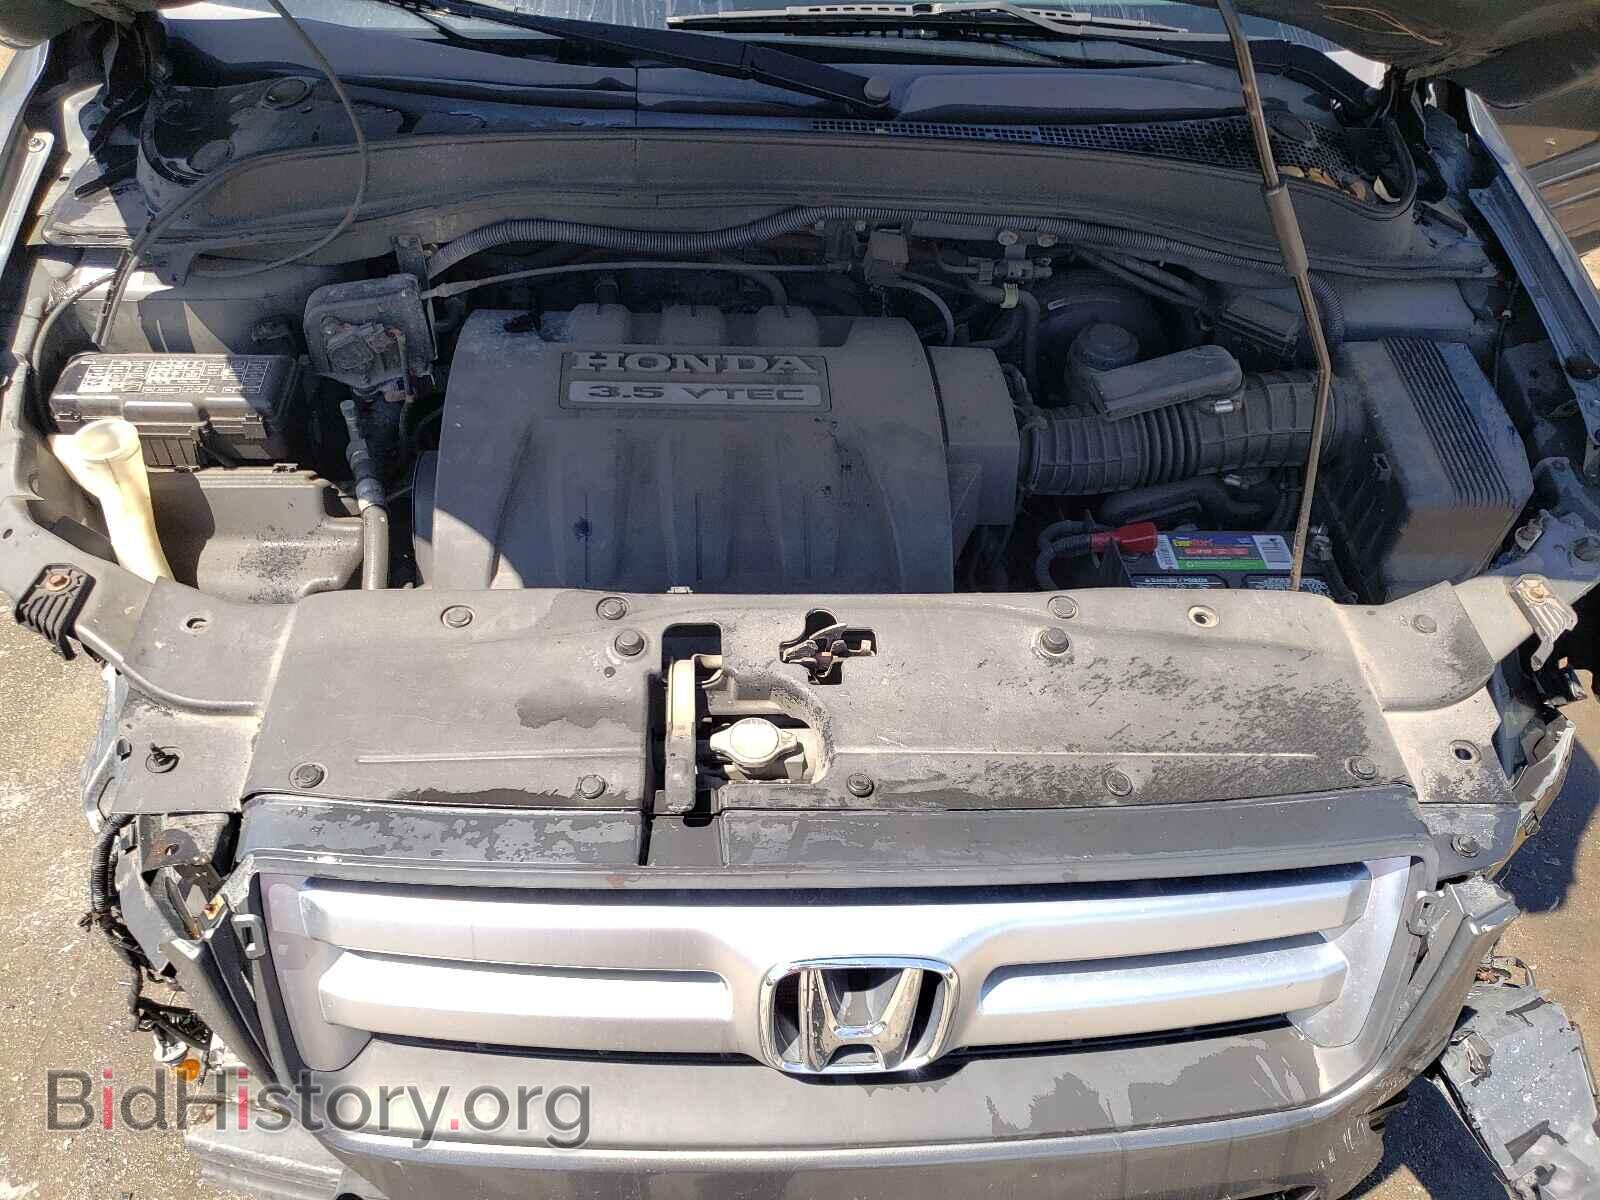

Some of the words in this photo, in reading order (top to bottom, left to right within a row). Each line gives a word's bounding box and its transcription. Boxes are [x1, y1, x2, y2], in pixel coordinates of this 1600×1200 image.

[571, 351, 818, 375] HONDA
[586, 385, 665, 399] 3.5
[682, 387, 805, 401] VTEC
